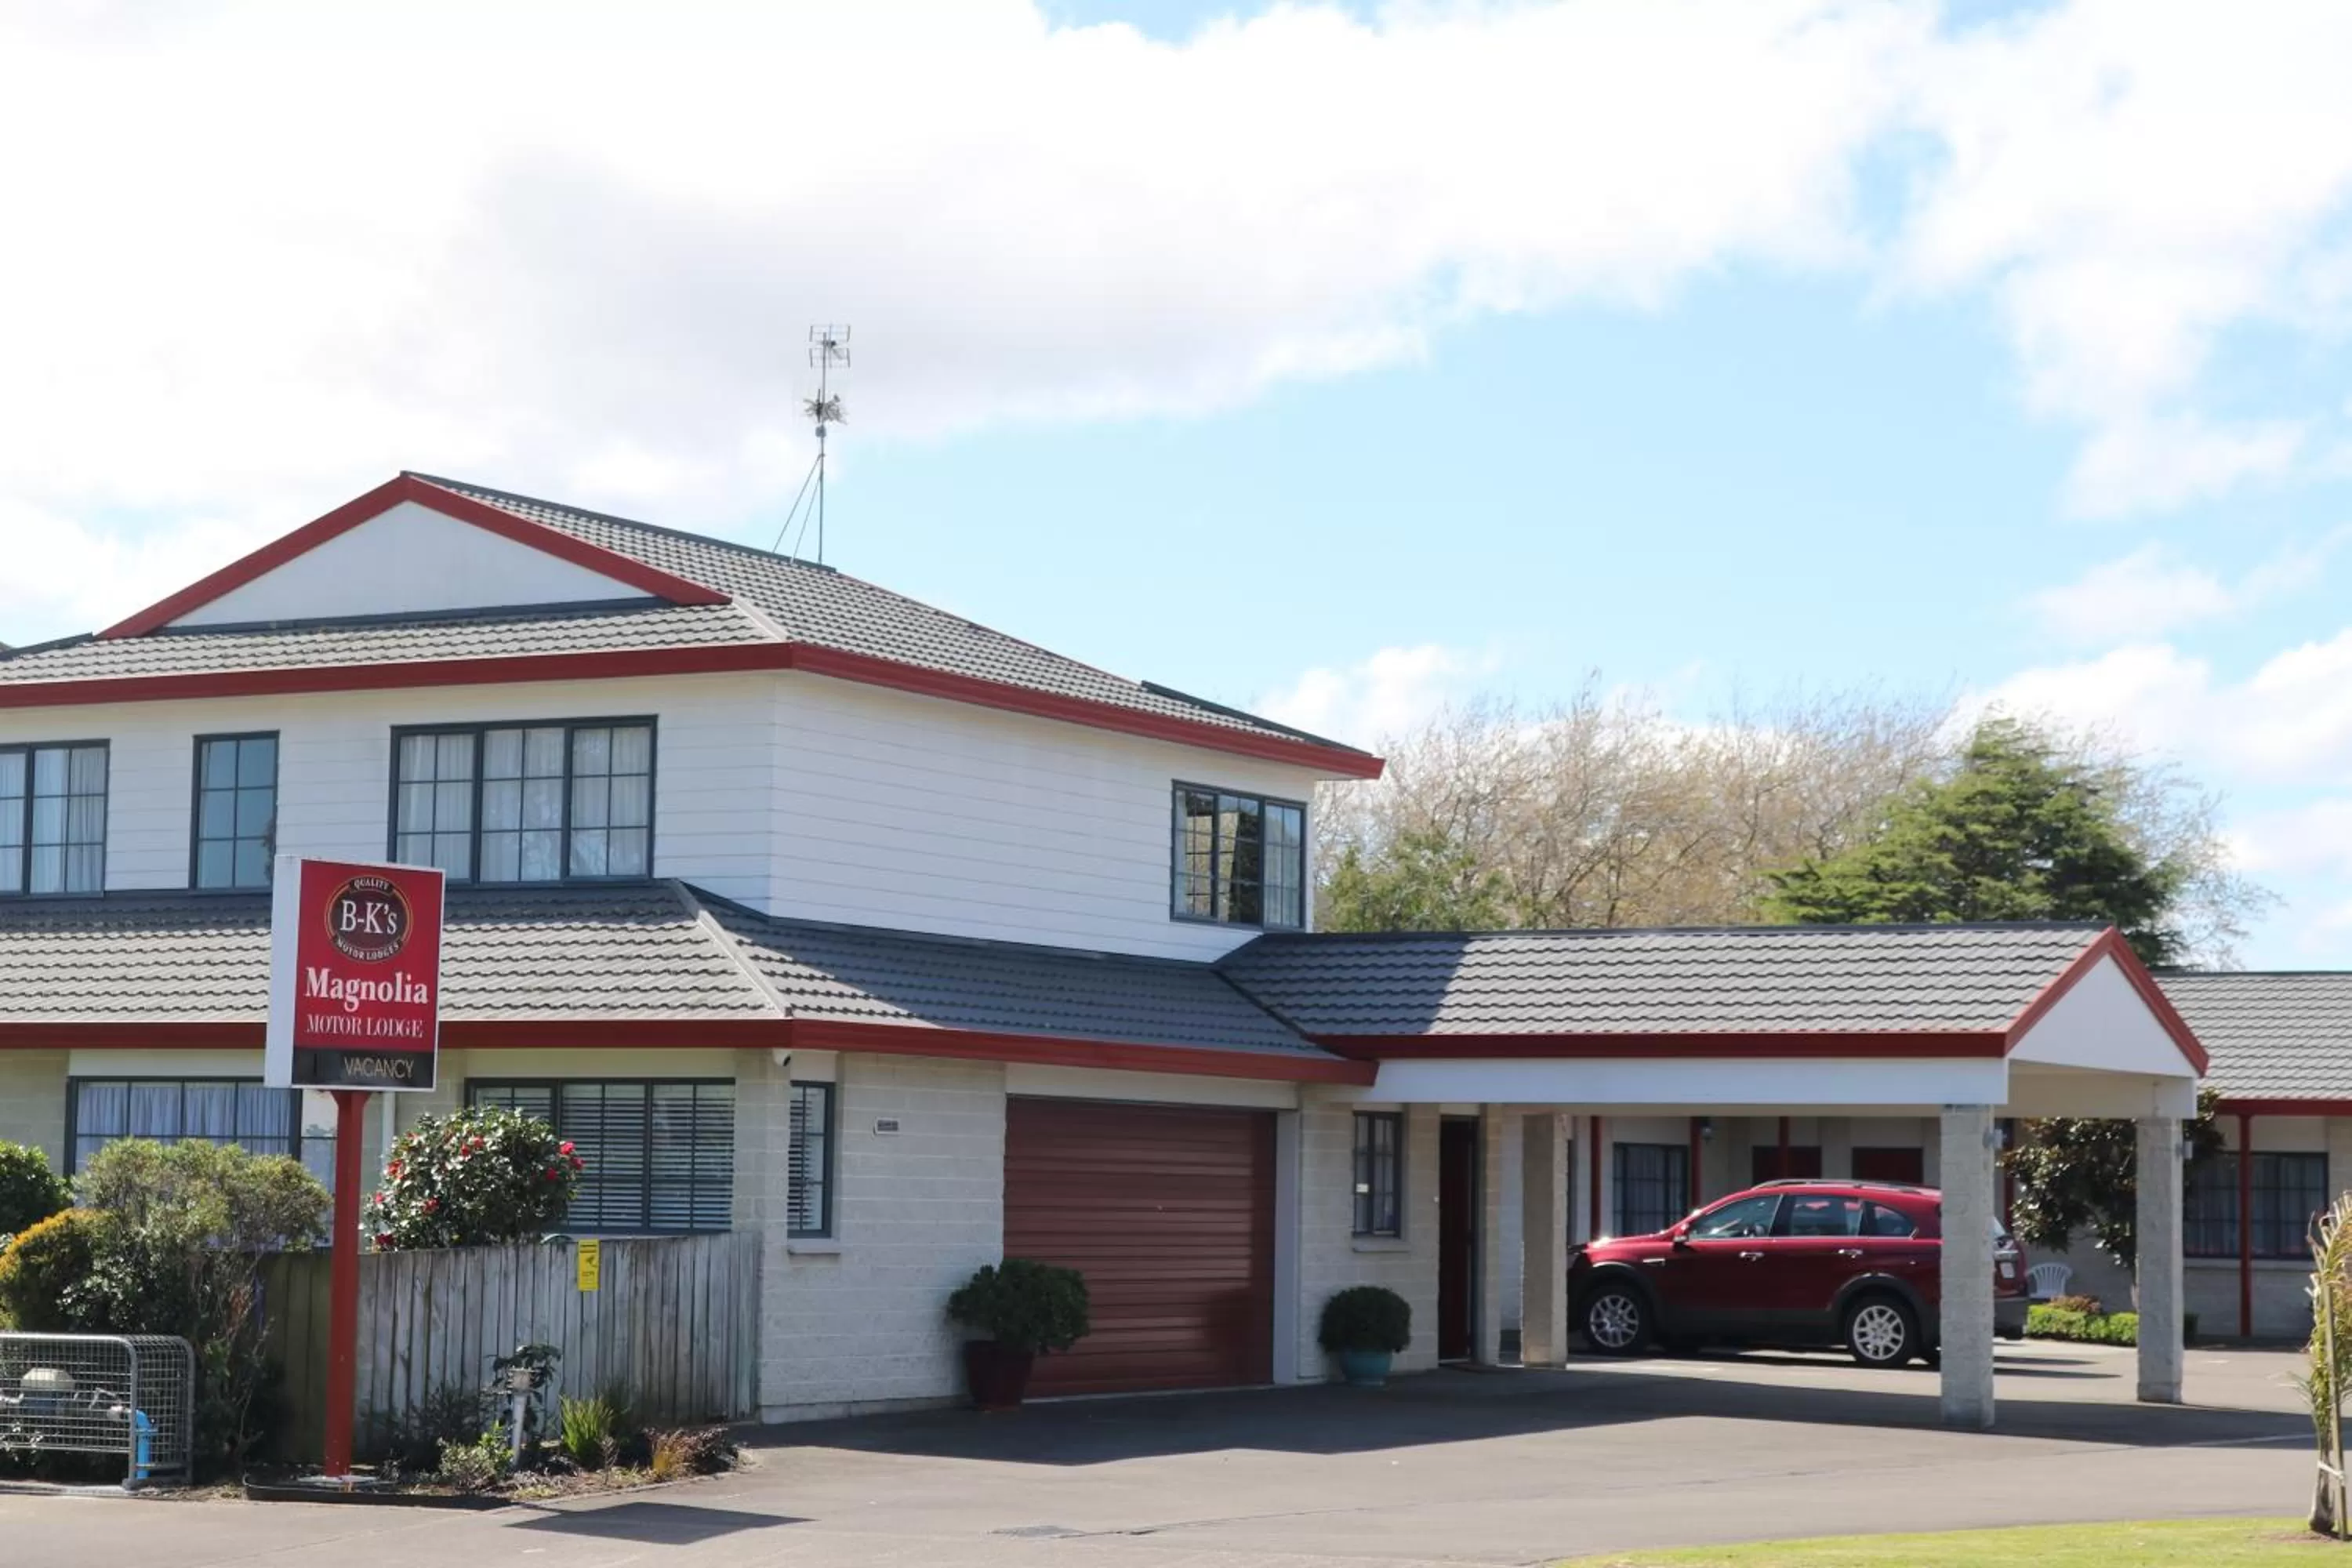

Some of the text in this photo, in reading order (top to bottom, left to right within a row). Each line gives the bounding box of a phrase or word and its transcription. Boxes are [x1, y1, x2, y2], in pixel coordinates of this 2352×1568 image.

[354, 877, 390, 890] QUALITY
[339, 899, 397, 935] B-K's
[337, 935, 399, 960] MOTOR LODGES
[305, 966, 429, 1012] Magnolia
[305, 1014, 423, 1039] MOTOR LODGE
[344, 1056, 415, 1079] VACANCY
